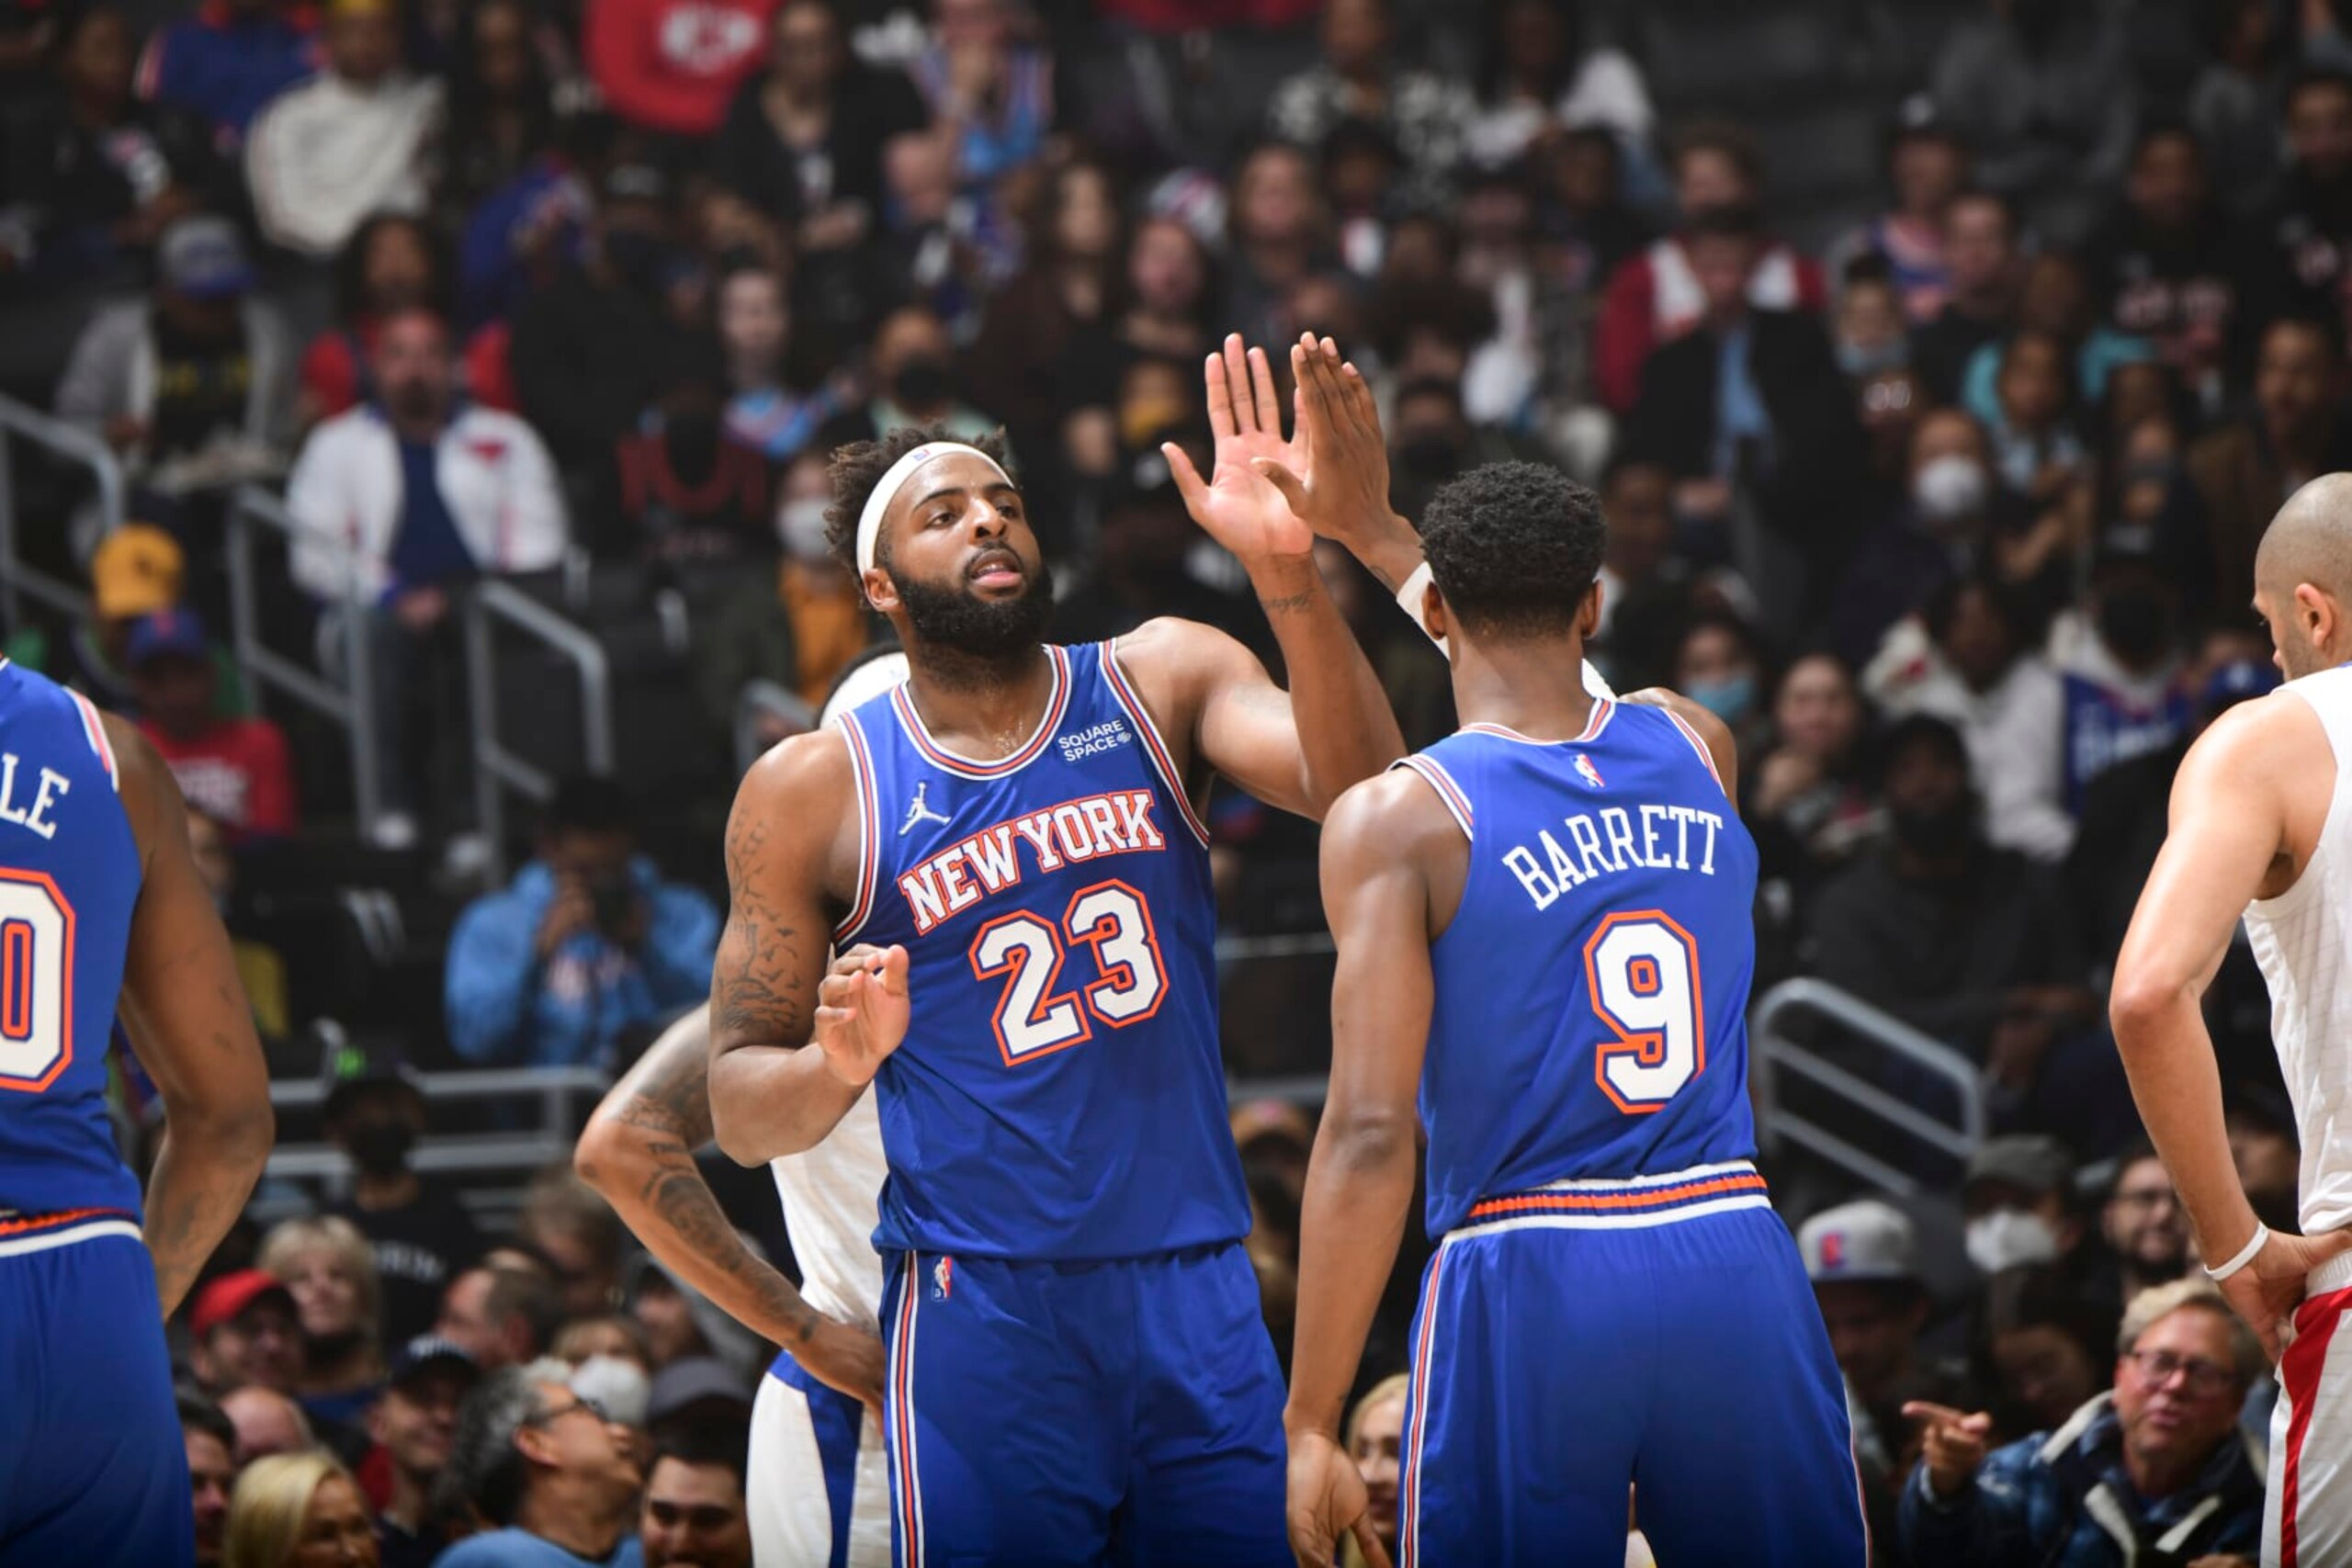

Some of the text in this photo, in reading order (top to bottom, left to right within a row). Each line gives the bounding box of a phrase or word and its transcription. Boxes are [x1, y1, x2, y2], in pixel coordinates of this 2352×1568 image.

[1057, 719, 1125, 750] SQUARE
[1064, 735, 1118, 762] SPACE
[897, 788, 1166, 936] NEW YORK
[1501, 804, 1724, 911] BARRETT
[967, 877, 1170, 1067] 23
[1582, 908, 1706, 1115] 9
